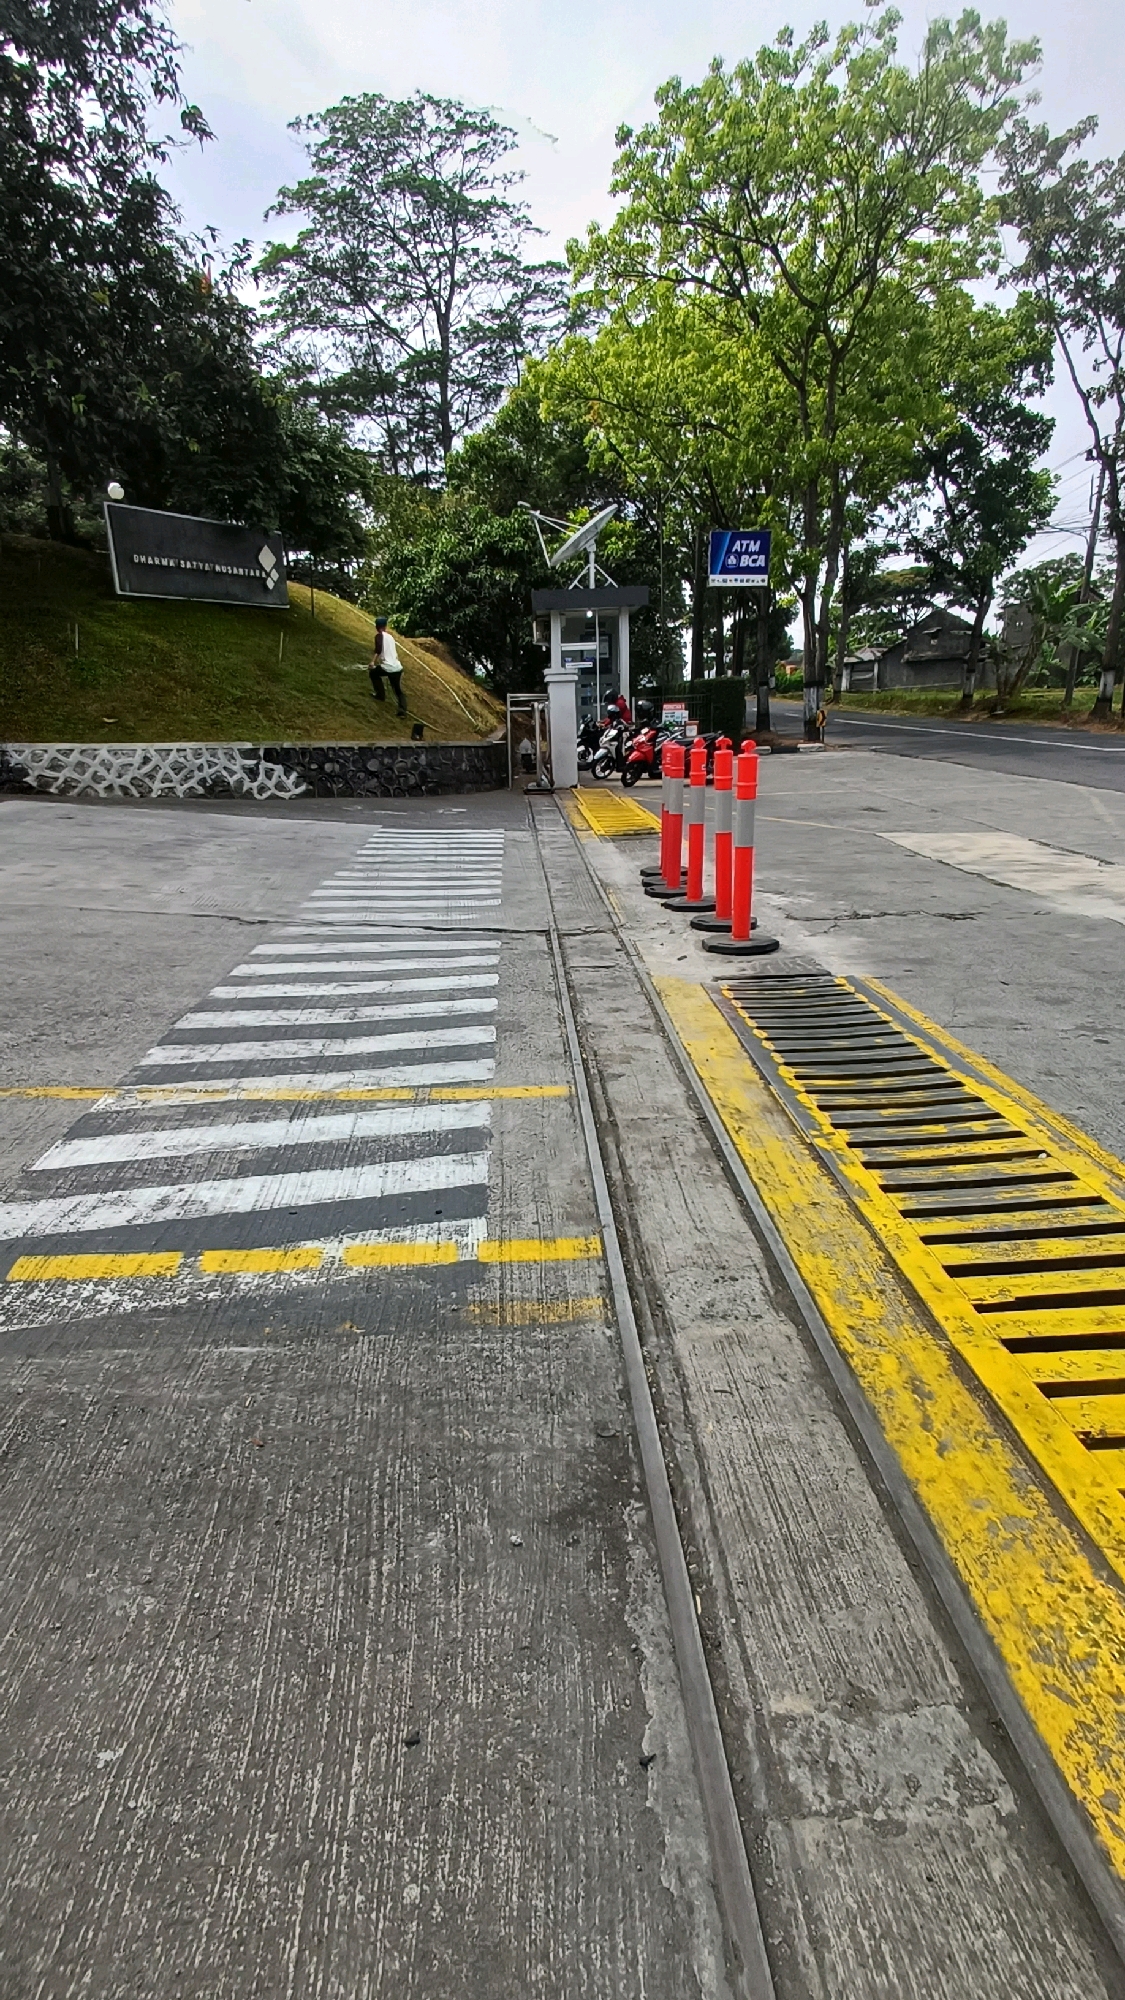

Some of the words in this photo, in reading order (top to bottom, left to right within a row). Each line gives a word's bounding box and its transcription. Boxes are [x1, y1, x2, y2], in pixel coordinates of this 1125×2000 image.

[731, 540, 761, 553] ATM
[133, 554, 176, 568] DHARMA
[180, 559, 211, 572] SATYA
[215, 564, 266, 578] NUSANTARA
[739, 554, 766, 567] BCA
